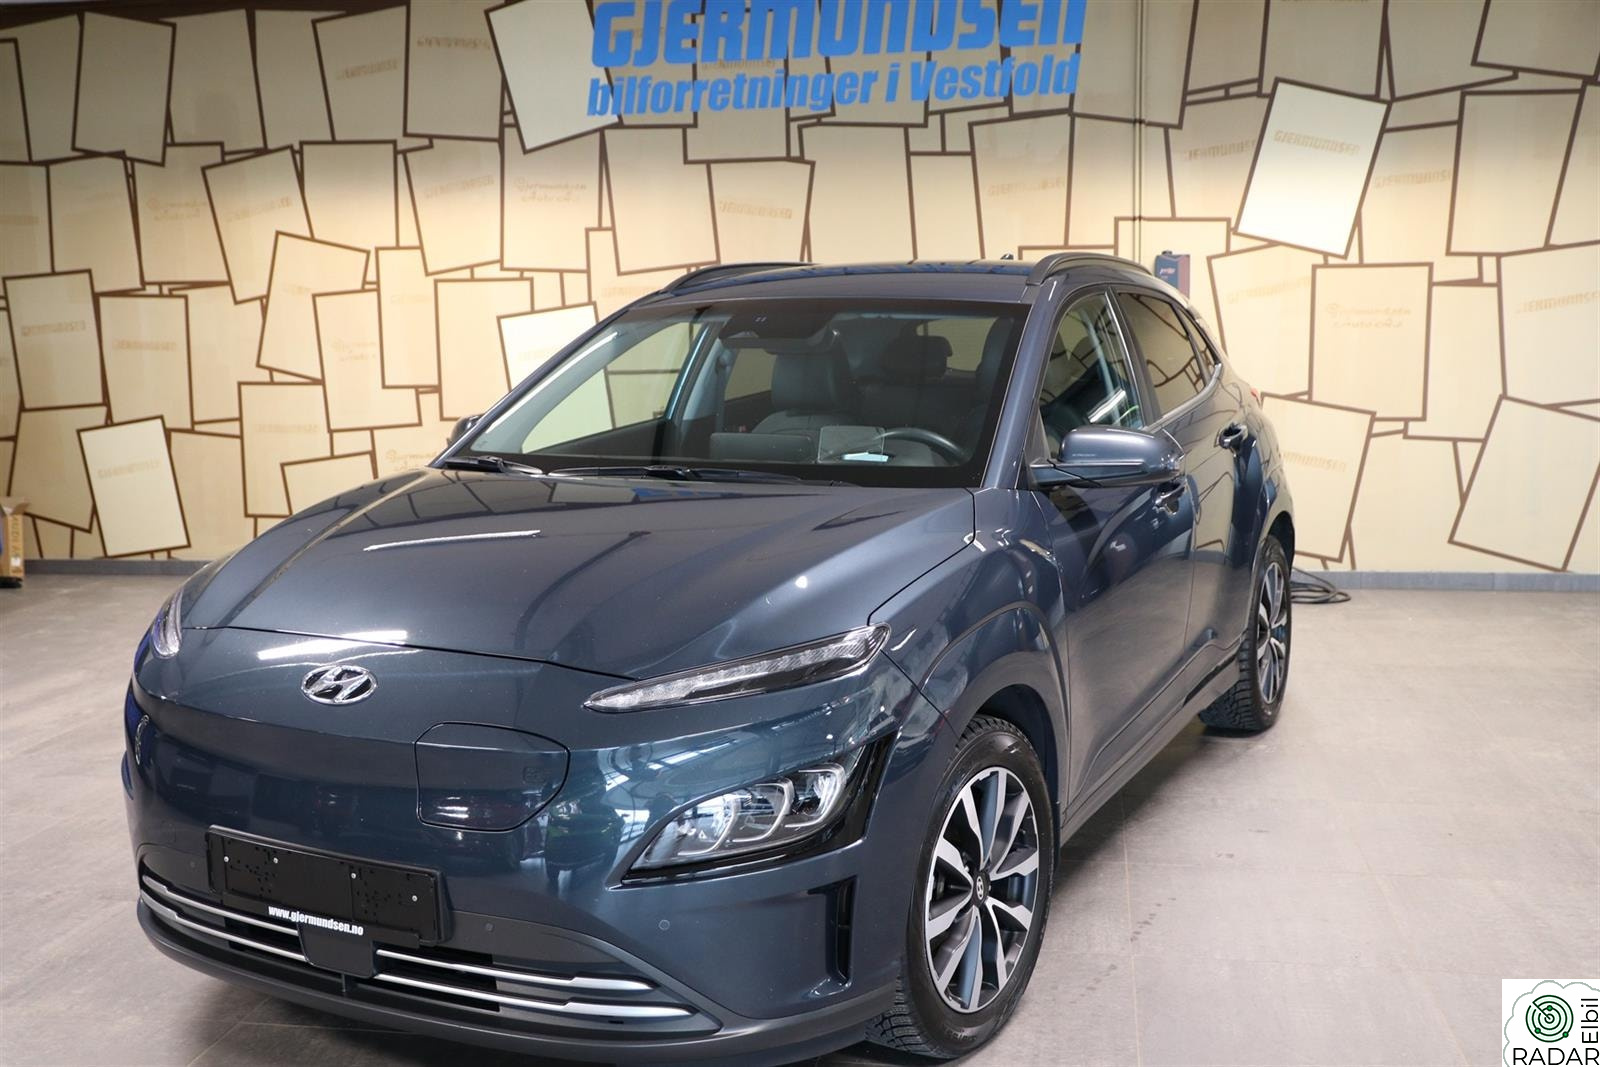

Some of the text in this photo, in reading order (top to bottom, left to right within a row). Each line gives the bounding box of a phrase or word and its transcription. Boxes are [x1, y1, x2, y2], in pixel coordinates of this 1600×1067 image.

[588, 53, 1081, 116] bilforretninger i Vestfold
[268, 905, 364, 936] www.gjermundsen.no
